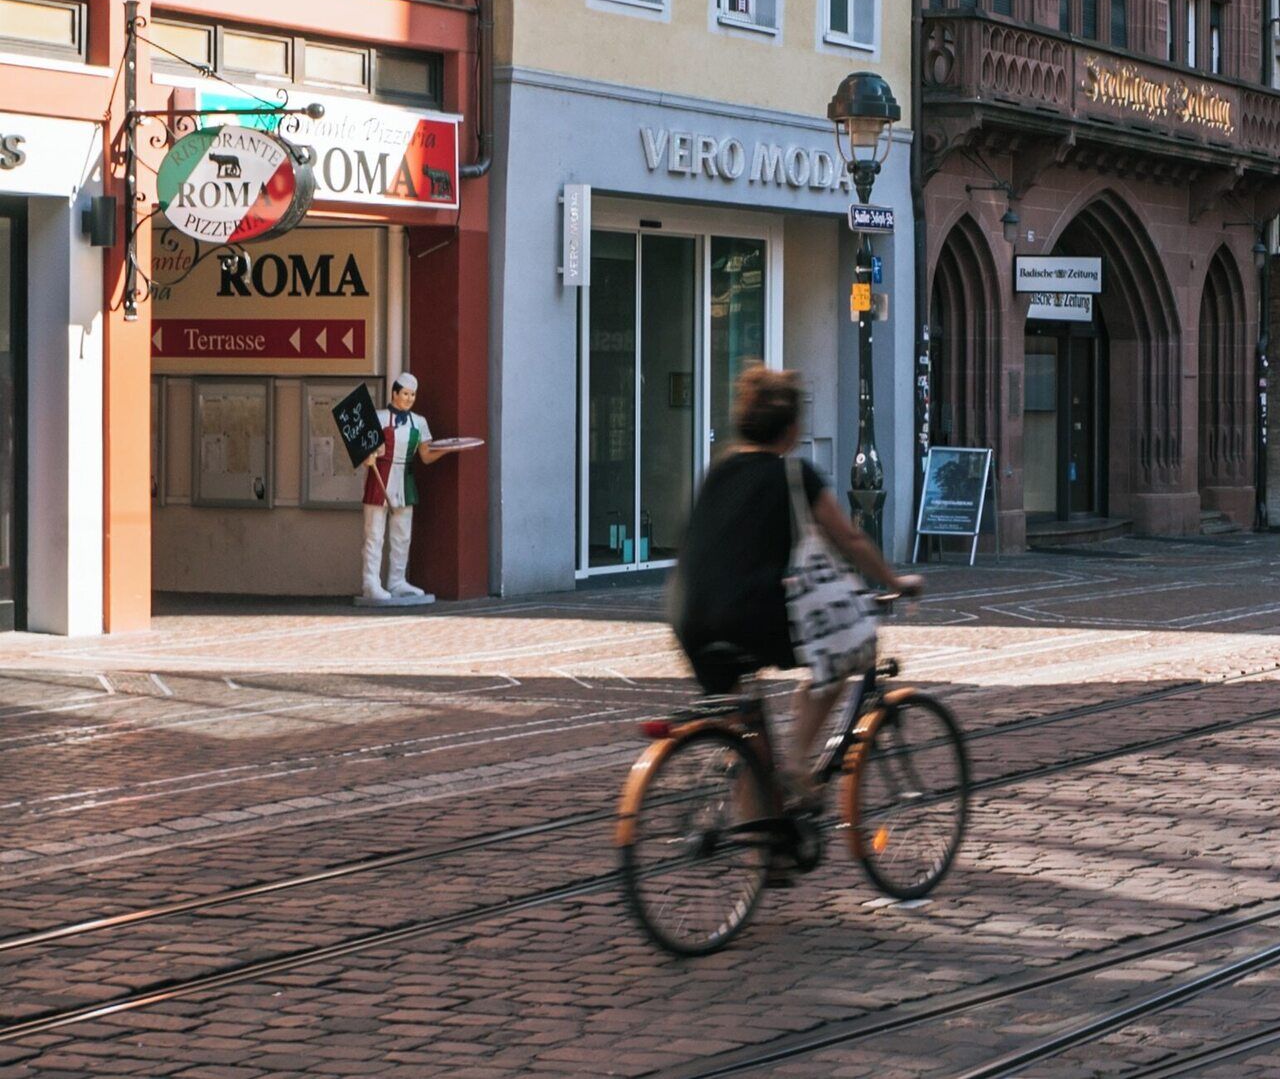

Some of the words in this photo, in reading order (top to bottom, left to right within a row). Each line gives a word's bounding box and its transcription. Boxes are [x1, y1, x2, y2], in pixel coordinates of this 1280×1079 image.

[171, 132, 282, 167] RISTORANTE
[639, 125, 745, 181] VERO
[749, 142, 851, 193] MODA
[177, 181, 273, 208] ROMA
[184, 213, 268, 236] PIZZERIA
[217, 253, 369, 298] ROMA
[1020, 268, 1053, 278] Badische
[1068, 269, 1098, 280] Zeitung
[184, 328, 266, 351] Terrasse
